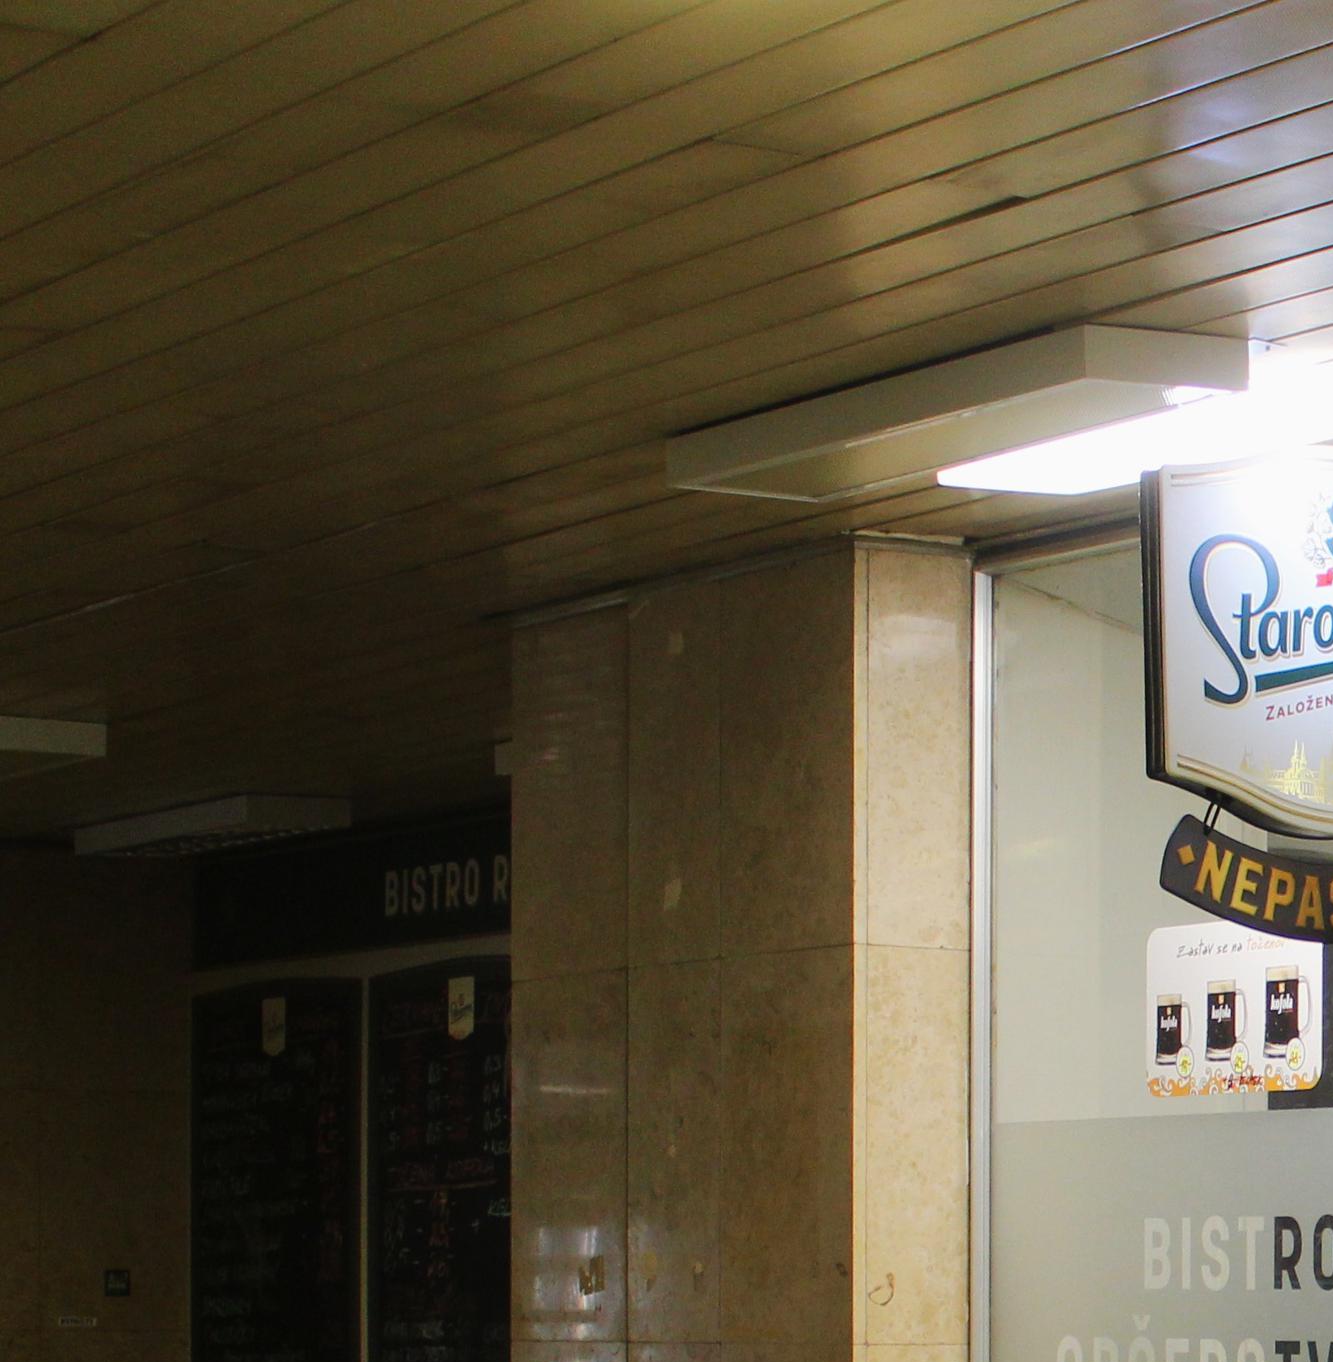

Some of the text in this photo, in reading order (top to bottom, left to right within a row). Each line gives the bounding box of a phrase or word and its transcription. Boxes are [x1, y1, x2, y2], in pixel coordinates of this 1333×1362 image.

[384, 857, 480, 917] BISTRO
[1177, 939, 1214, 958] Zastav
[1217, 945, 1229, 955] se
[1232, 943, 1243, 954] na
[1271, 993, 1294, 1015] kofola
